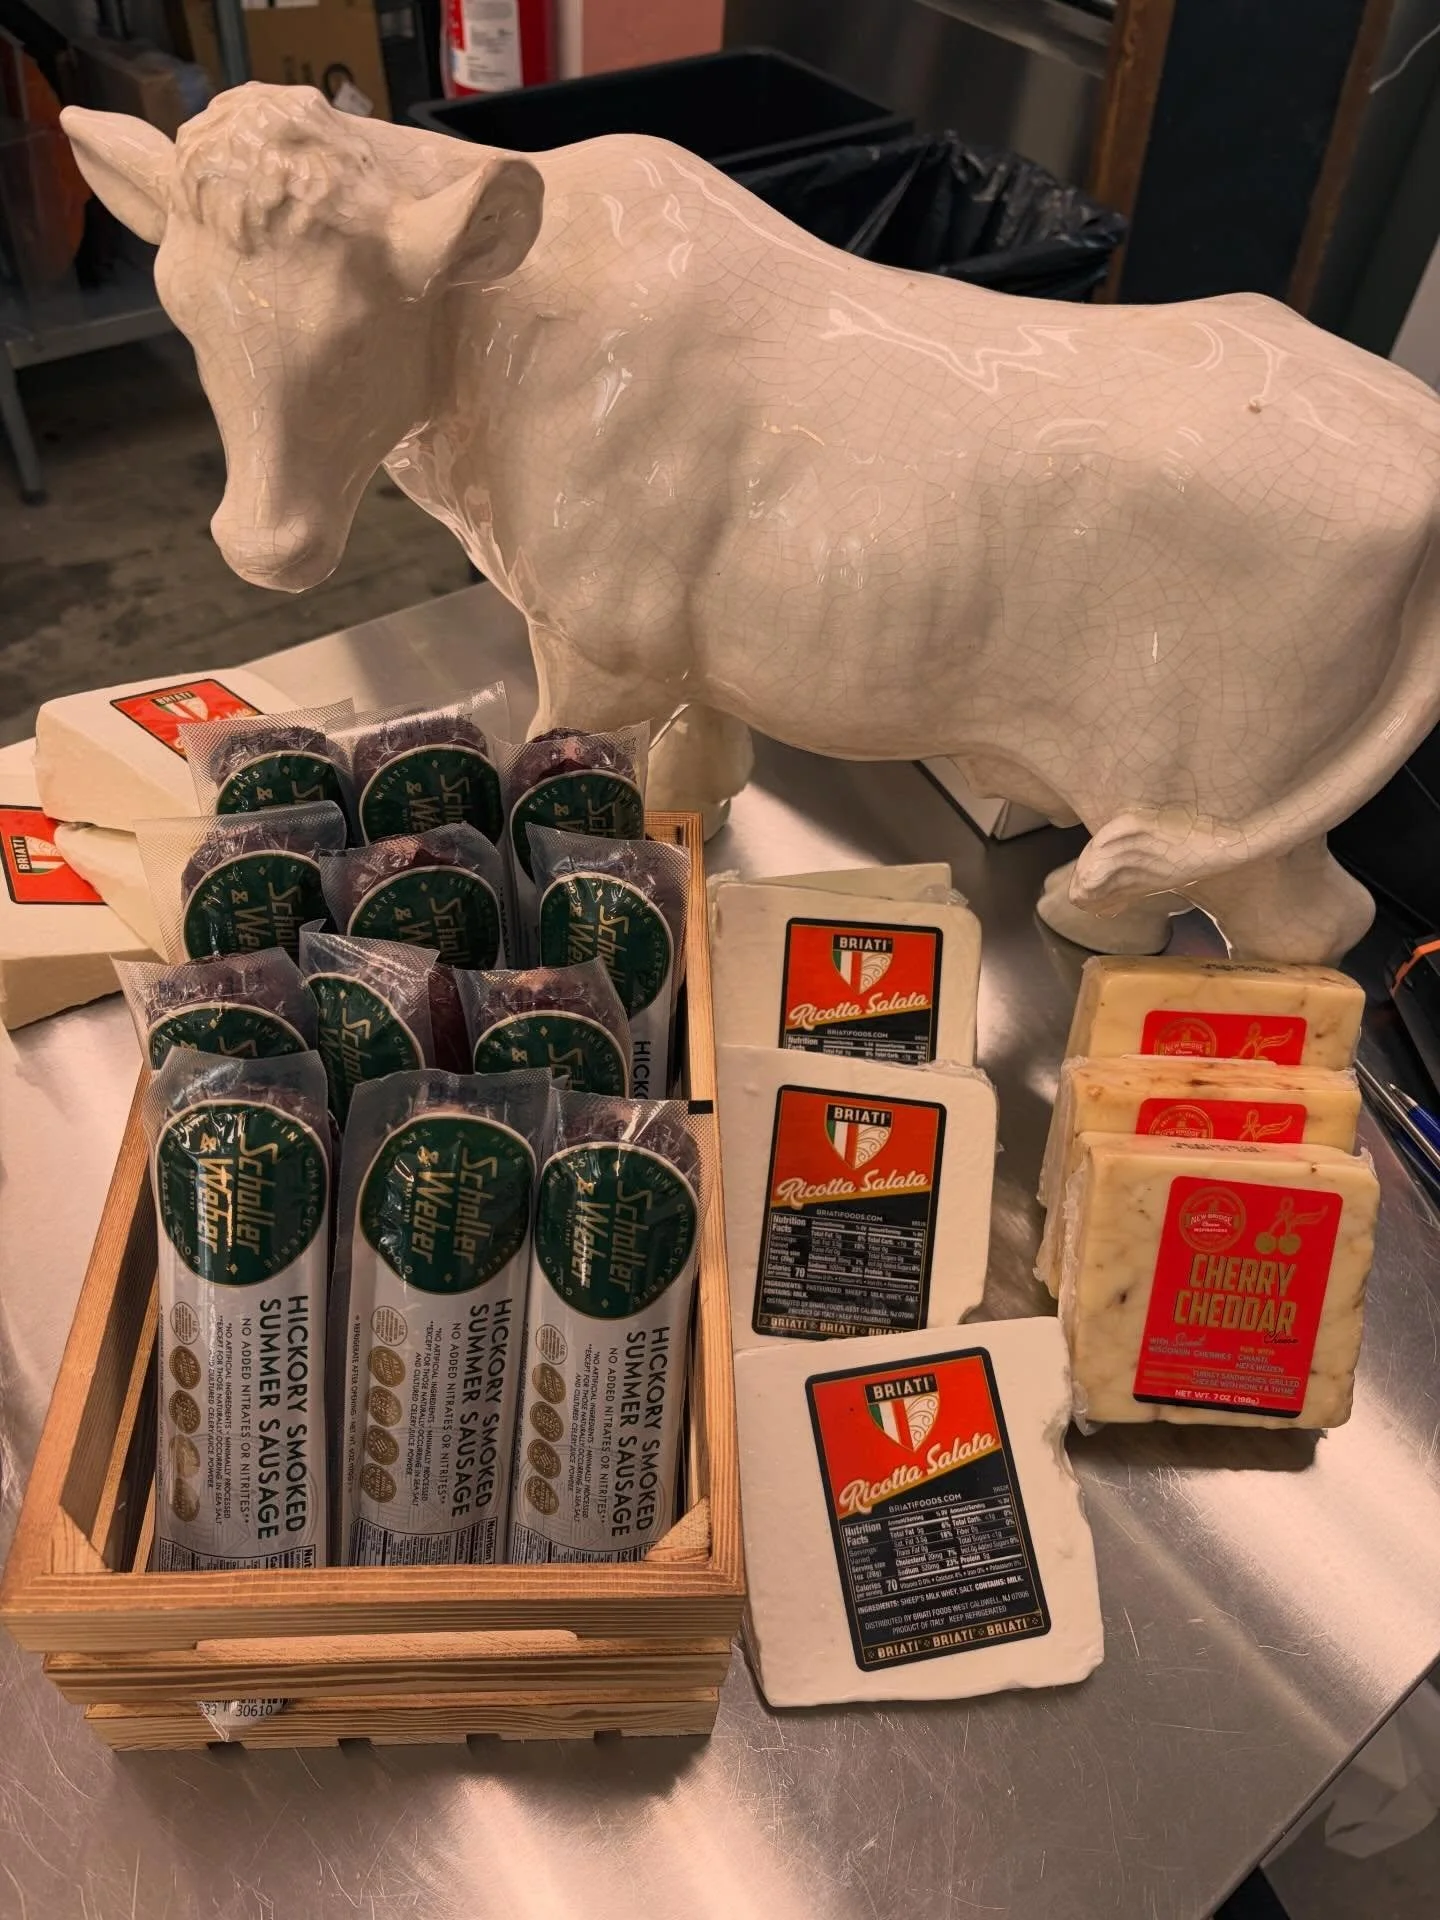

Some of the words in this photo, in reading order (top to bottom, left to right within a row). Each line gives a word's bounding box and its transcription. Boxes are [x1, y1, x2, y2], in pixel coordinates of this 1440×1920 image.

[155, 691, 194, 705] BRIATI
[17, 839, 30, 870] BRIATI
[839, 936, 887, 951] BRIATI
[788, 1002, 862, 1031] Ricotta
[866, 991, 929, 1014] Salata
[787, 1036, 818, 1046] Nutrition
[826, 1028, 889, 1039] BRIATIFOODS.COM
[834, 1106, 887, 1125] BRIATI
[198, 1157, 235, 1254] Weber
[235, 1133, 280, 1256] Scholler
[453, 1147, 499, 1265] Scholler
[777, 1177, 856, 1210] Ricotta
[860, 1168, 929, 1192] Salata
[410, 1171, 458, 1265] Weber
[772, 1224, 792, 1233] Facts
[773, 1215, 806, 1227] Nutrition
[816, 1209, 883, 1222] BRIATIFOODS.COM
[570, 1200, 612, 1289] Weber
[608, 1178, 654, 1293] Scholler
[795, 1266, 806, 1278] 70
[1188, 1253, 1298, 1297] CHERRY
[241, 1318, 252, 1337] NO
[451, 1322, 462, 1340] NO
[771, 1317, 807, 1330] BRIATI
[819, 1321, 856, 1335] BRIATI
[1172, 1290, 1298, 1337] CHEDDAR
[225, 1340, 233, 1380] ARTIFICIAL
[241, 1341, 252, 1380] ADDED
[259, 1298, 282, 1409] SUMMER
[287, 1295, 309, 1413] HICKORY
[414, 1352, 422, 1368] AND
[423, 1353, 432, 1368] FOR
[432, 1343, 441, 1379] ARTIFICIAL
[447, 1343, 460, 1379] ADDED
[462, 1303, 490, 1405] SUMMER
[485, 1298, 513, 1404] HICKORY
[608, 1347, 618, 1364] NO
[411, 1369, 421, 1402] CULTURED
[421, 1368, 430, 1390] THOSE
[582, 1374, 590, 1388] FOR
[590, 1366, 600, 1401] ARTIFICIAL
[605, 1367, 616, 1402] ADDED
[619, 1330, 647, 1428] SUMMER
[643, 1326, 671, 1430] HICKORY
[873, 1377, 931, 1399] BRIATI
[1174, 1389, 1191, 1399] NET
[1194, 1391, 1212, 1400] WT.
[224, 1381, 232, 1429] INGREDIENTS
[240, 1384, 252, 1438] NITRATES
[409, 1403, 418, 1427] CELERY
[419, 1391, 428, 1428] NATURALLY
[428, 1380, 437, 1423] INGREDIENTS
[443, 1383, 457, 1431] NITRATES
[581, 1388, 589, 1410] THOSE
[578, 1411, 587, 1448] NATURALLY
[587, 1402, 596, 1443] INGREDIENTS
[601, 1405, 614, 1453] NITRATES
[224, 1436, 232, 1478] MINIMALLY
[240, 1442, 251, 1459] OR
[425, 1430, 433, 1463] MINIMALLY
[441, 1434, 452, 1449] OR
[286, 1423, 308, 1532] SMOKED
[451, 1411, 479, 1518] SAUSAGE
[475, 1412, 500, 1508] SMOKED
[584, 1449, 593, 1483] MINIMALLY
[599, 1455, 610, 1470] OR
[838, 1463, 923, 1515] Ricotta
[925, 1431, 997, 1474] Salata
[258, 1418, 282, 1540] SAUSAGE
[421, 1465, 431, 1502] PROCESSED
[611, 1435, 638, 1537] SAUSAGE
[636, 1439, 661, 1531] SMOKED
[223, 1479, 231, 1519] PROCESSED
[888, 1493, 962, 1513] BRIATIFOODS.COM
[844, 1522, 882, 1537] Nutrition
[952, 1517, 966, 1527] Total
[847, 1536, 869, 1547] Facts
[960, 1555, 981, 1564] Protein
[855, 1582, 882, 1592] Calories
[885, 1579, 898, 1591] 70
[857, 1599, 900, 1615] INGREDIENTS:
[900, 1594, 925, 1605] SHEEP'S
[925, 1591, 940, 1601] MILK
[974, 1578, 1006, 1591] CONTAINS:
[1006, 1574, 1024, 1585] MILK.
[864, 1615, 903, 1631] DISTRIBUTED
[903, 1614, 912, 1622] BY
[912, 1610, 932, 1621] BRIATI
[932, 1606, 952, 1617] FOODS
[952, 1602, 969, 1613] WEST
[1002, 1593, 1011, 1602] NJ
[892, 1623, 920, 1636] PRODUCT
[920, 1621, 929, 1630] OF
[929, 1617, 945, 1628] ITALY
[948, 1613, 964, 1623] KEEP
[964, 1604, 1007, 1619] REFRIGERATED
[877, 1640, 919, 1659] BRIATI
[932, 1628, 974, 1648] BRIATI
[986, 1617, 1028, 1637] BRIATI
